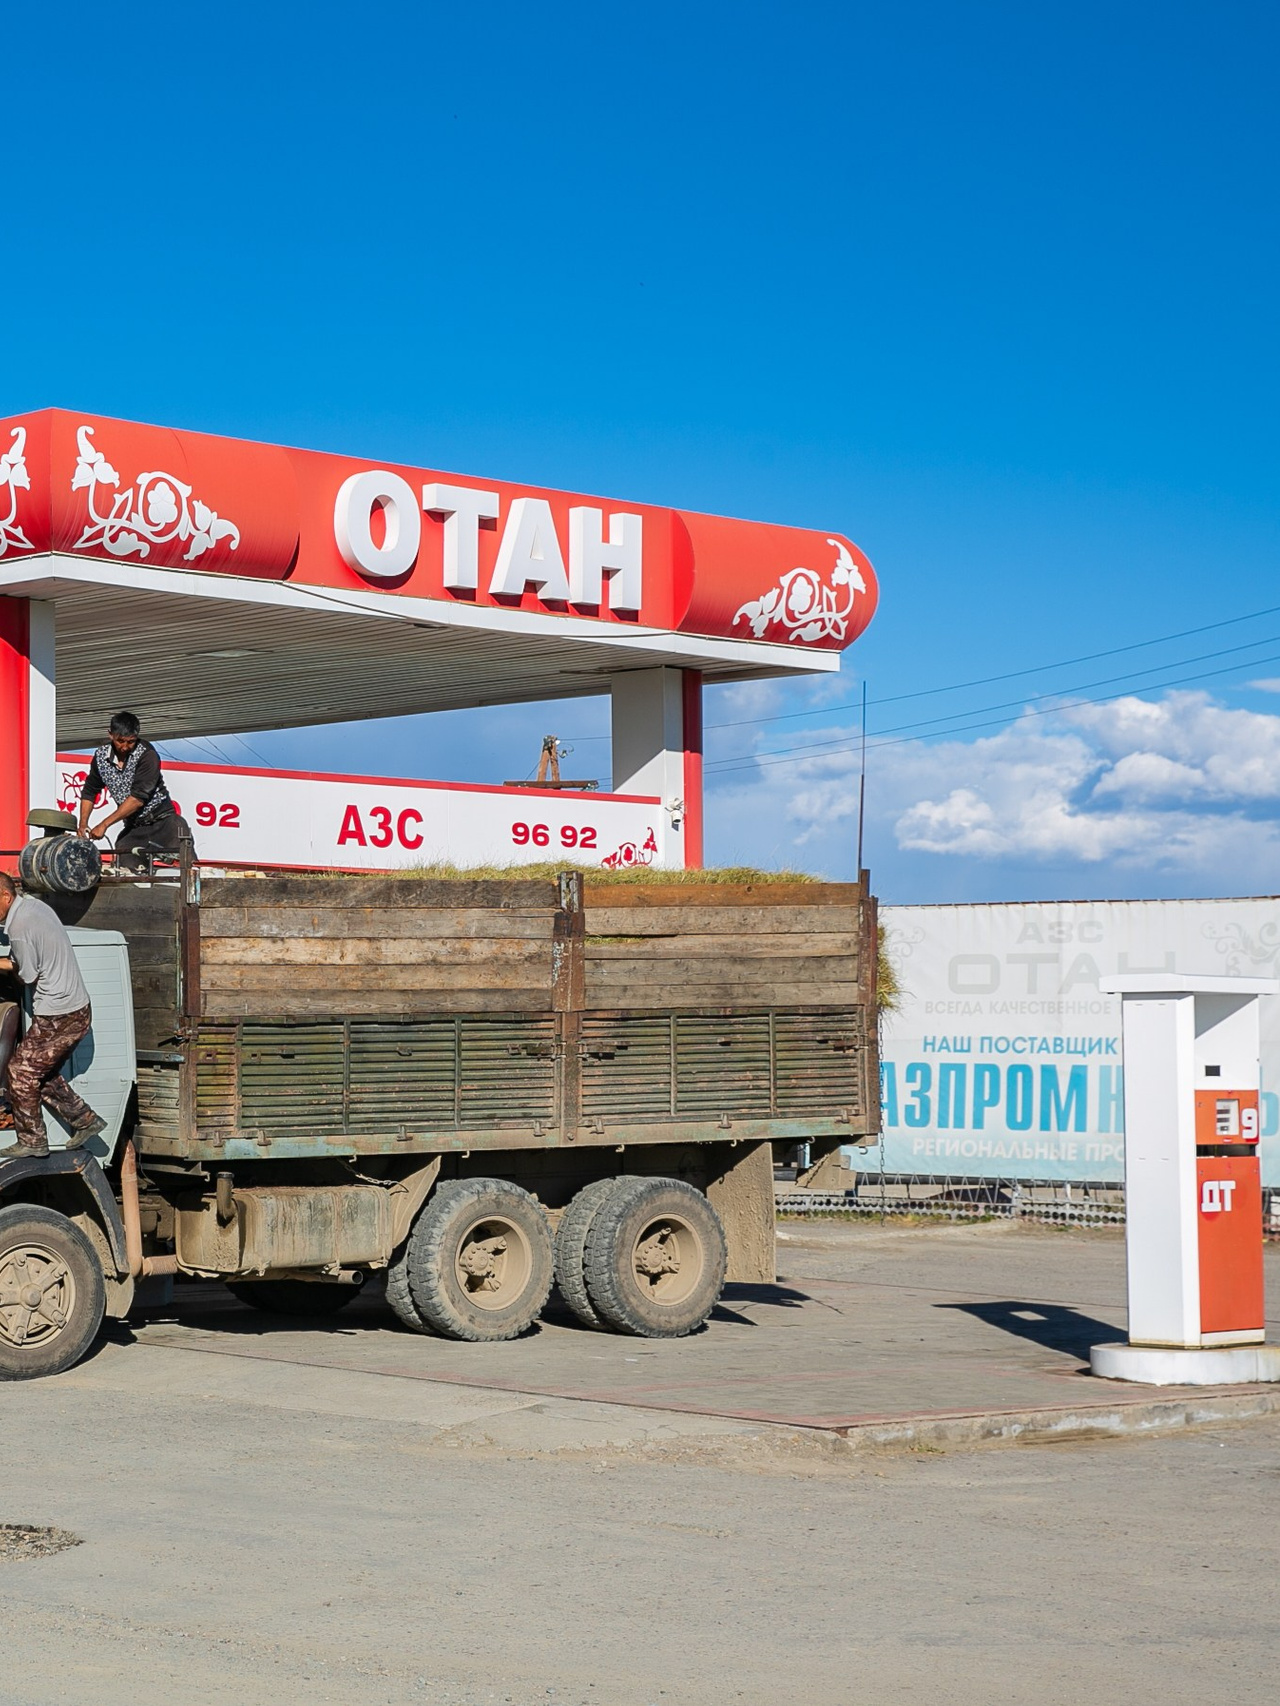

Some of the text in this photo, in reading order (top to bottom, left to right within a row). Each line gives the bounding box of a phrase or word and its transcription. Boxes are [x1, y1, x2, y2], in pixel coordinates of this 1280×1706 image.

[334, 470, 642, 610] ОТАН
[196, 801, 240, 828] 92
[337, 804, 424, 850] АЗС
[511, 822, 597, 849] 96 92
[1016, 920, 1104, 944] АЗС
[924, 1000, 983, 1016] ВСЕГДА
[989, 1000, 1112, 1016] КАЧЕСТВЕННОЕ
[923, 1036, 1118, 1057] НАШ ПОСТАВЩИК
[913, 1137, 1077, 1161] РЕГИОНАЛЬНЫЕ
[1201, 1180, 1236, 1212] ДТ
